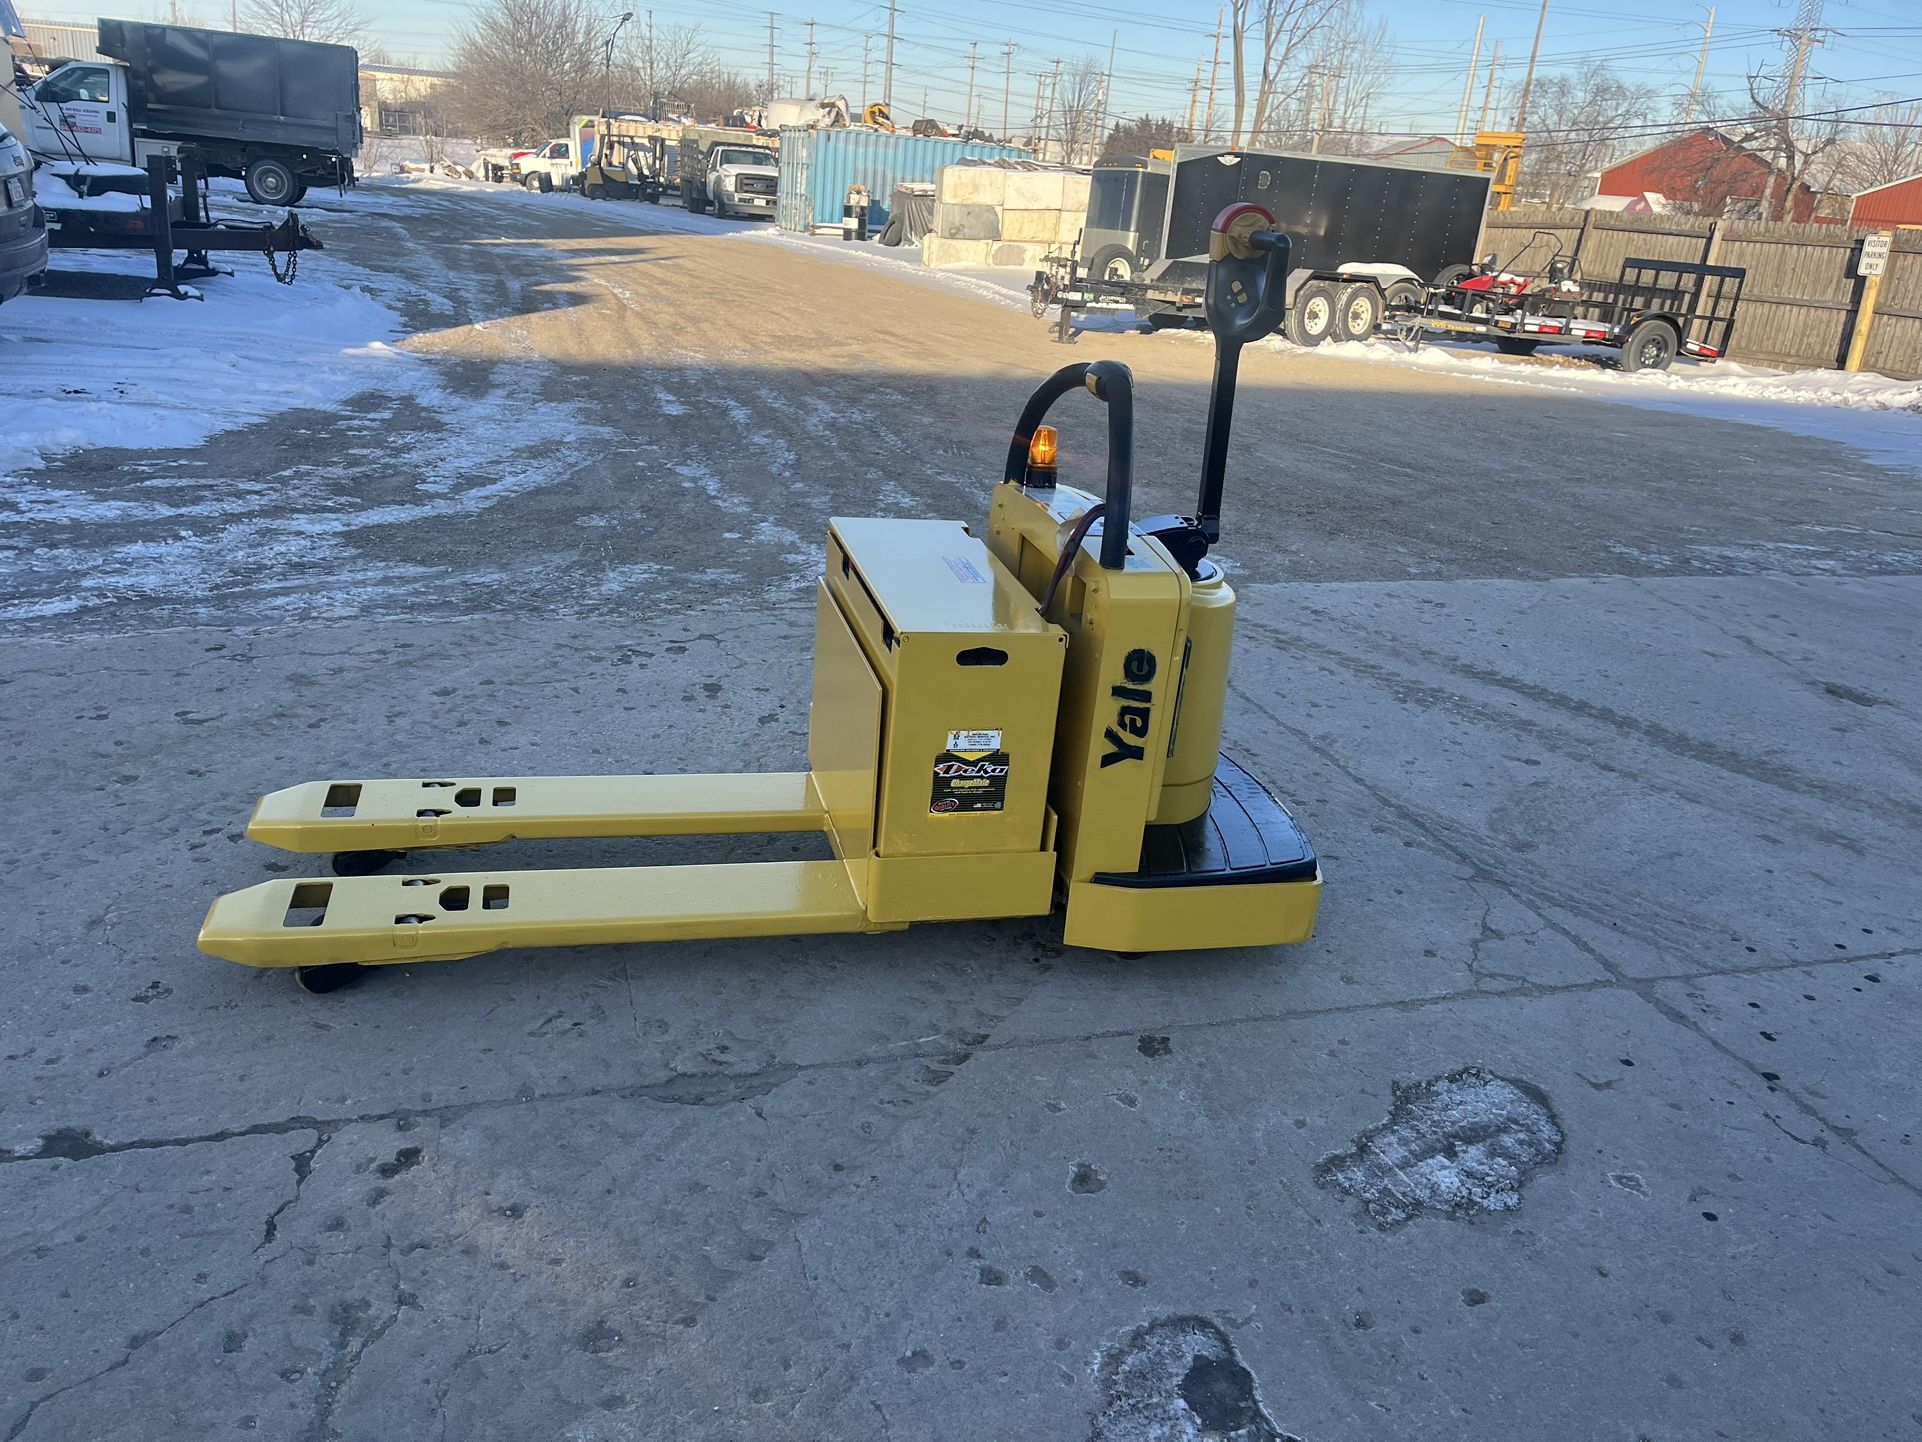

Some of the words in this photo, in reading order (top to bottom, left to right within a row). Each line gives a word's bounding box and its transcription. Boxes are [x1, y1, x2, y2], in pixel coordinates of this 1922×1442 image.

[1867, 240, 1888, 248] VISITOR
[1864, 250, 1886, 259] PARKING
[1864, 262, 1879, 271] ONLY
[1100, 648, 1157, 769] Yale
[934, 762, 1008, 777] Deka
